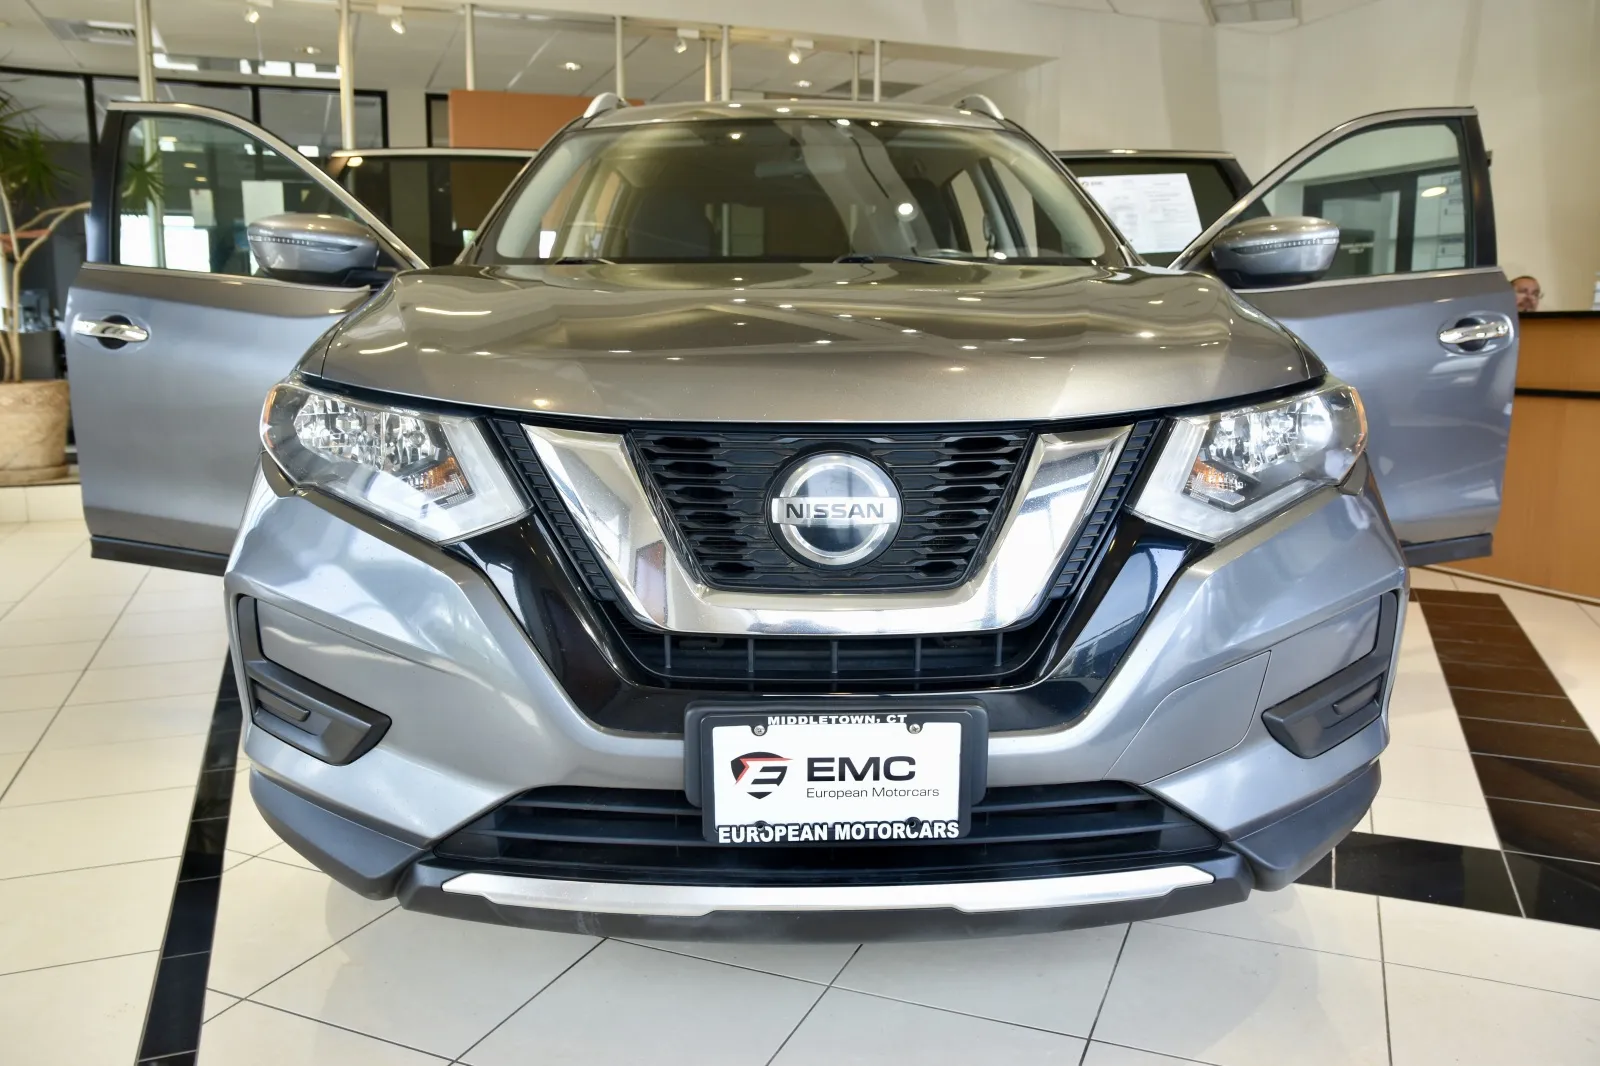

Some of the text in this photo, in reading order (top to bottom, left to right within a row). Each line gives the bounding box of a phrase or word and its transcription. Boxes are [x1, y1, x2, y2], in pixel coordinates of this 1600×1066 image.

[786, 503, 884, 518] NISSAN
[767, 714, 908, 726] MIDDLETOWN, CT
[807, 756, 916, 782] EMC
[806, 787, 940, 799] European Motorcars
[718, 822, 960, 843] EUROPEAN MOTORCARS
